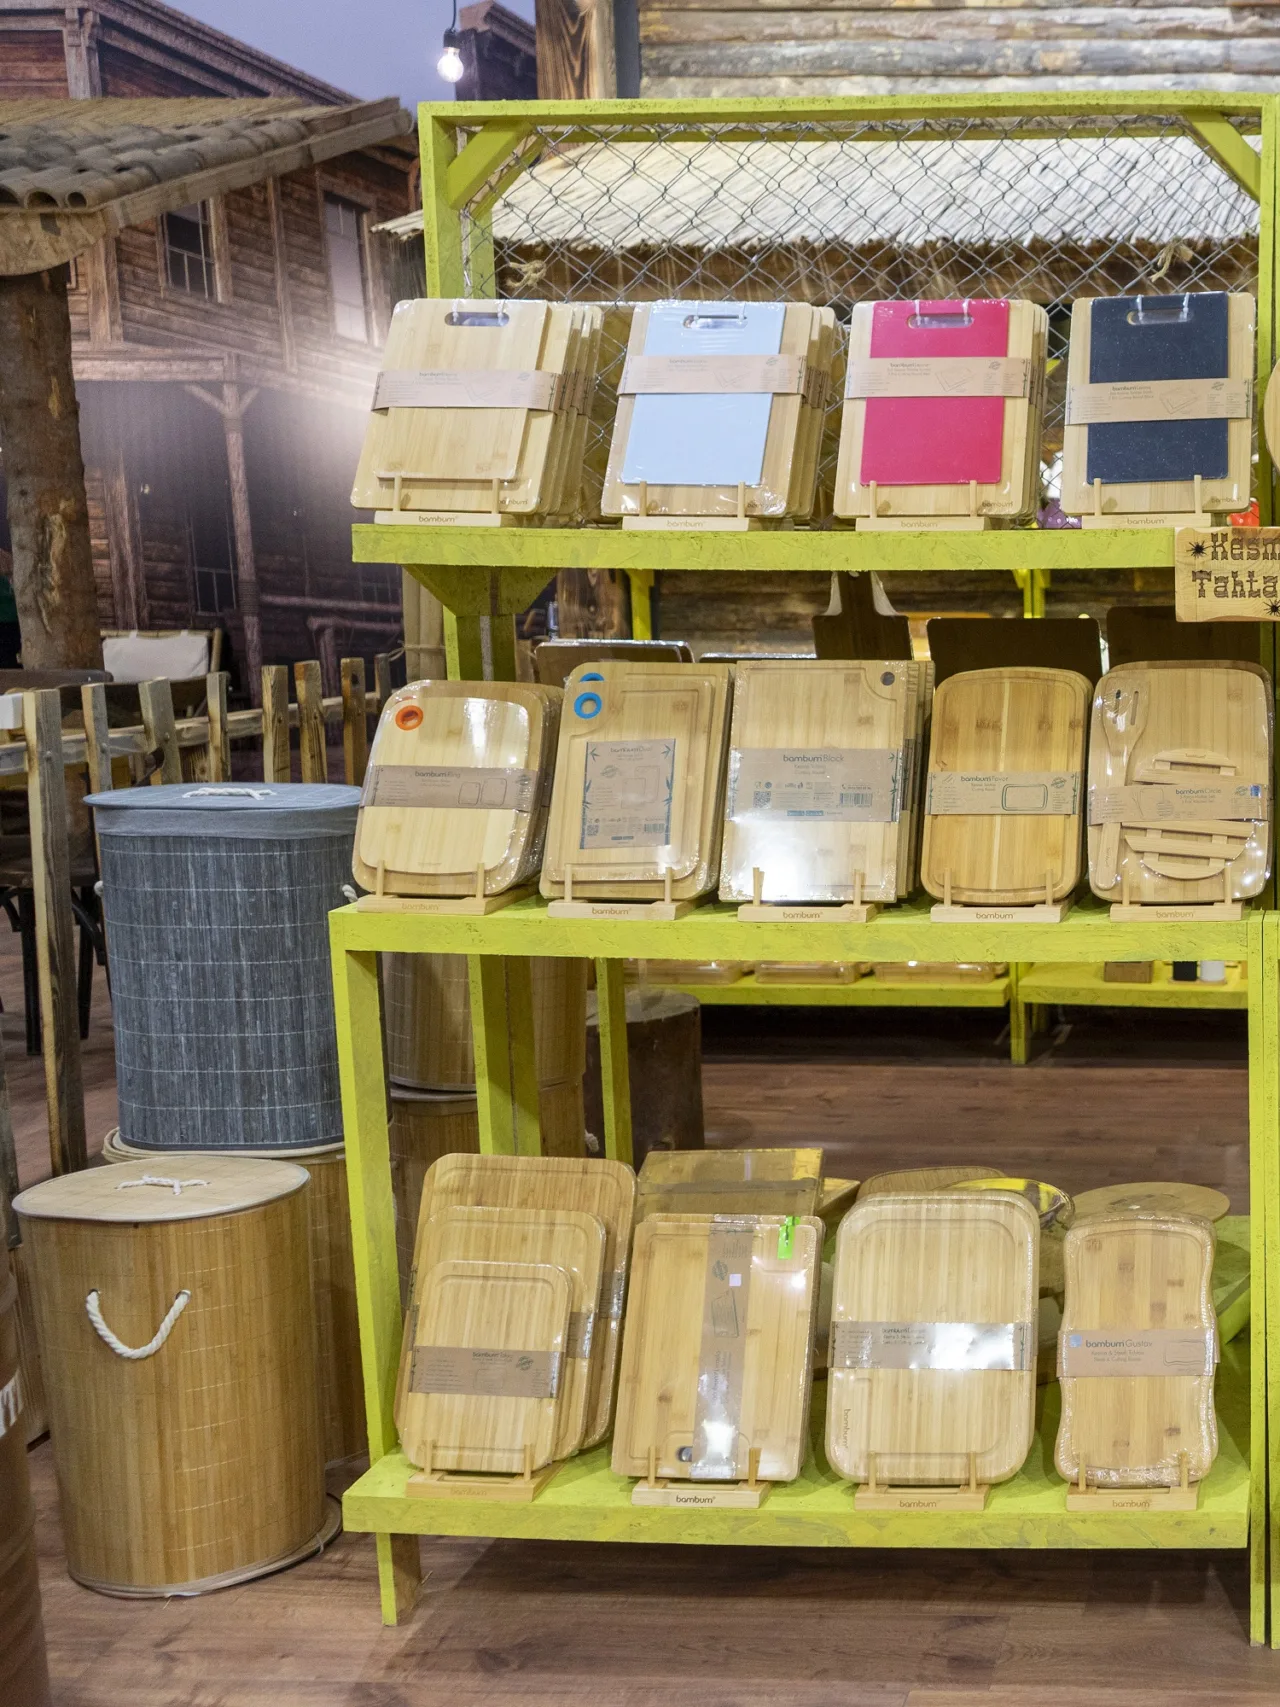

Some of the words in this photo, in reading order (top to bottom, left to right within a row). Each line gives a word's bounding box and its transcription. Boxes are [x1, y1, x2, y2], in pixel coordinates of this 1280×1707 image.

[419, 515, 455, 523] bambum
[667, 519, 703, 527] bambum
[1127, 517, 1165, 525] bambum
[901, 520, 938, 528] bambum
[783, 754, 822, 762] bambum
[823, 754, 844, 762] Block
[401, 903, 439, 912] bambum
[592, 907, 629, 915] bambum
[783, 911, 821, 919] bambum
[1086, 1340, 1124, 1348] bambum
[1126, 1338, 1153, 1348] Gustav
[676, 1495, 713, 1504] bambum
[900, 1500, 937, 1508] bambum
[1112, 1500, 1150, 1508] bambum
